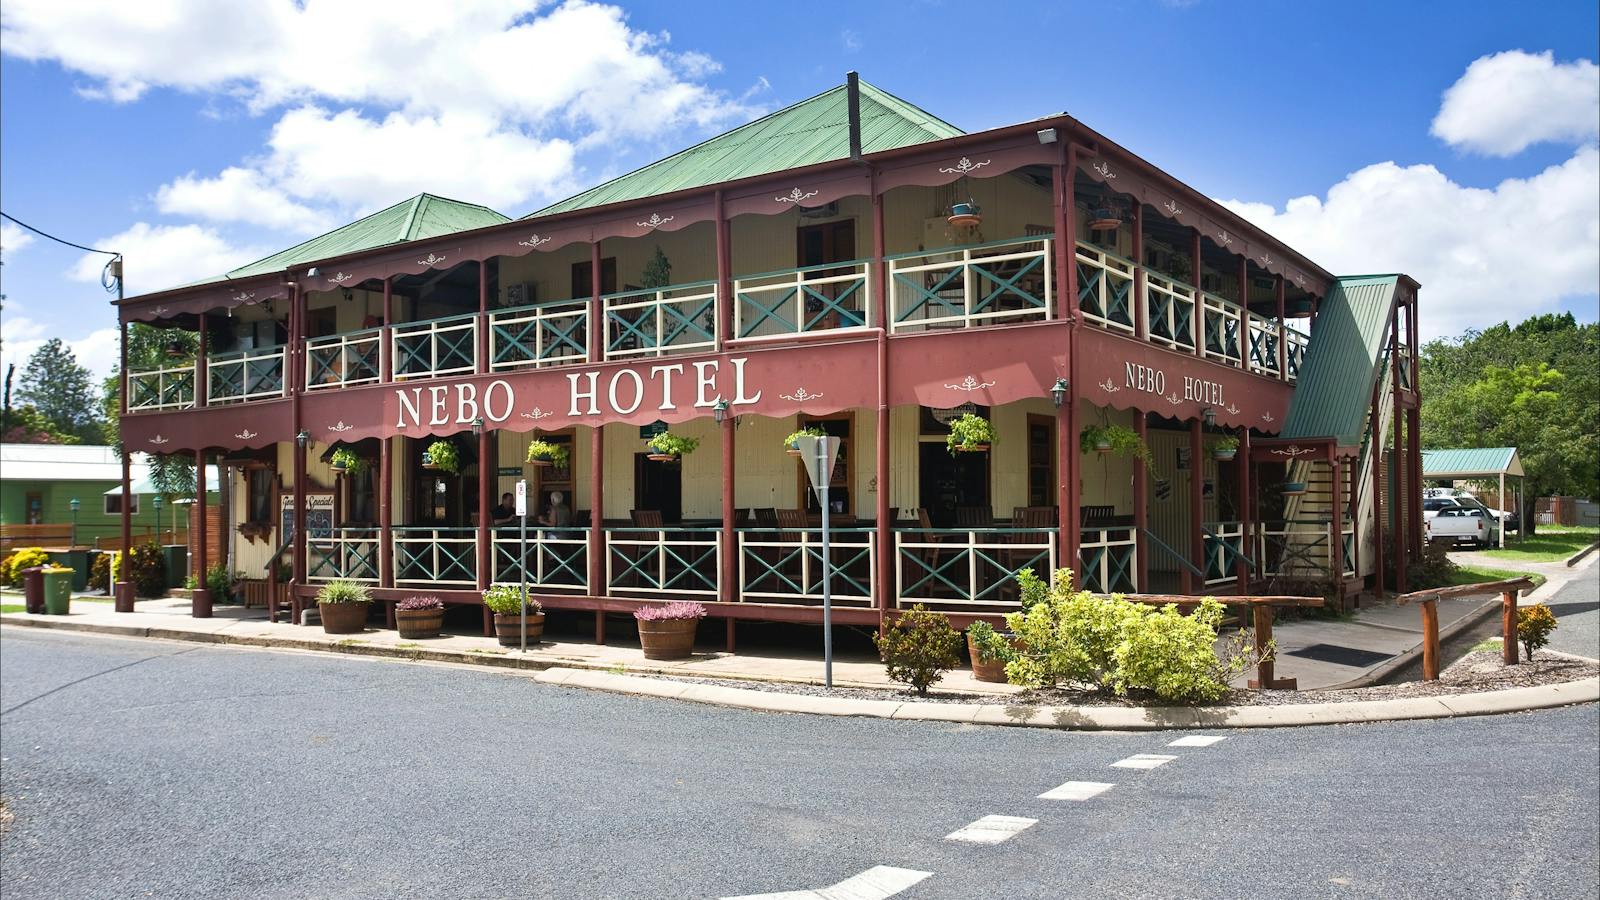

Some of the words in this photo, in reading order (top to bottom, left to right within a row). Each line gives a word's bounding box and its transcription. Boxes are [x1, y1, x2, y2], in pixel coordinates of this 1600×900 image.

[396, 380, 515, 428] NEBO
[566, 357, 762, 416] HOTEL
[1125, 362, 1165, 396] NEBO
[1184, 376, 1225, 407] HOTEL
